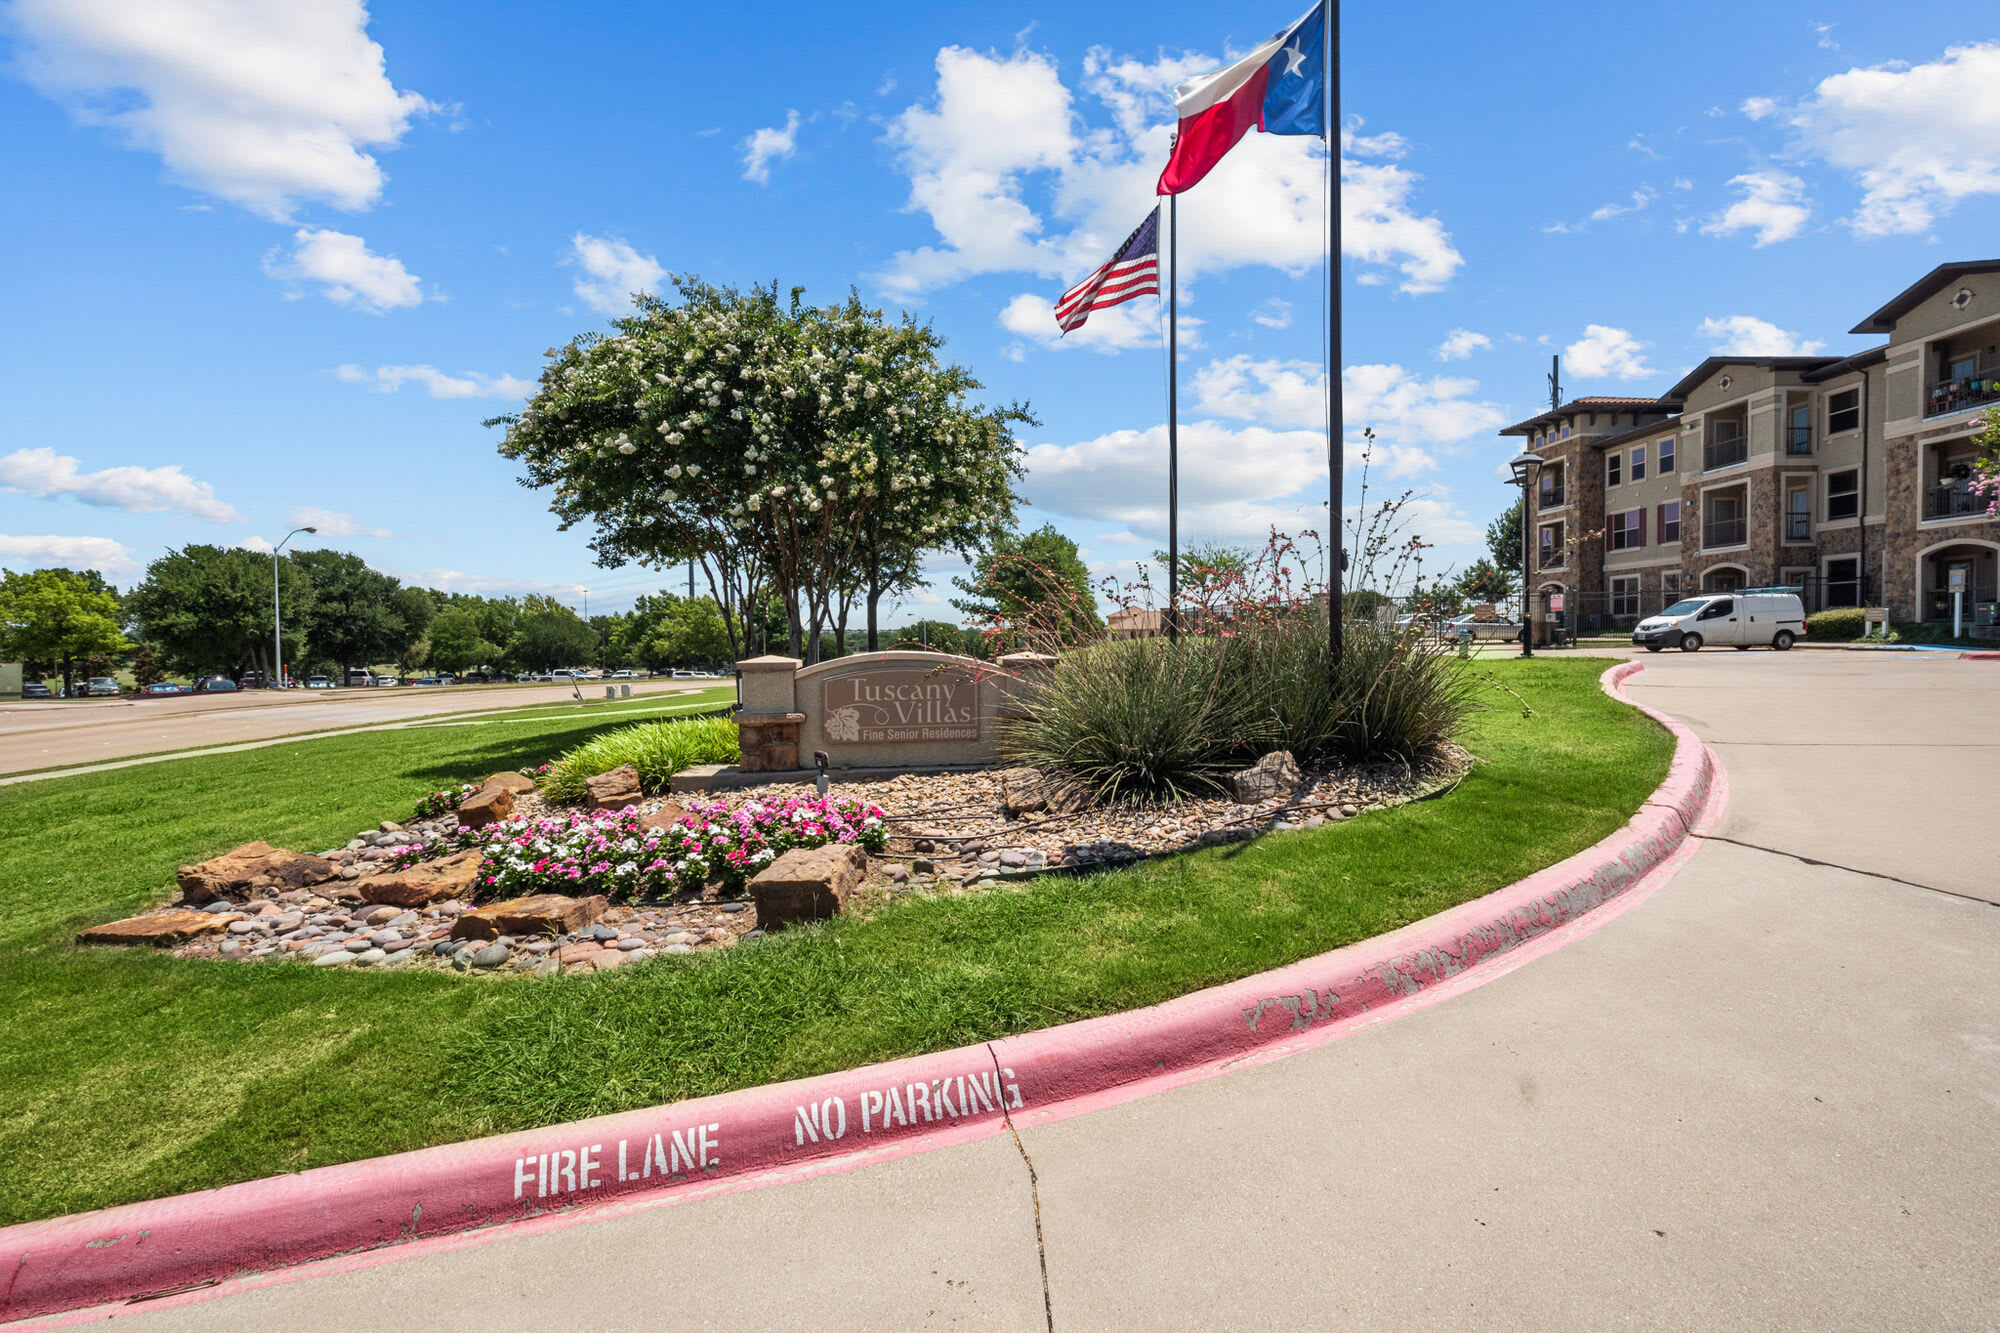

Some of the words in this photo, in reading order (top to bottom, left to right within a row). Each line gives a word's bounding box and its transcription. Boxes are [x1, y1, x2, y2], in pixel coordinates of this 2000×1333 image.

[847, 678, 957, 707] Tuscany
[893, 700, 971, 724] Villas
[863, 730, 884, 741] Fine
[887, 729, 920, 740] Senior
[922, 727, 977, 739] Residences
[514, 1144, 601, 1199] FIRE
[618, 1123, 720, 1183] LANE
[795, 1096, 846, 1145] NO
[860, 1068, 1023, 1133] PARKING
